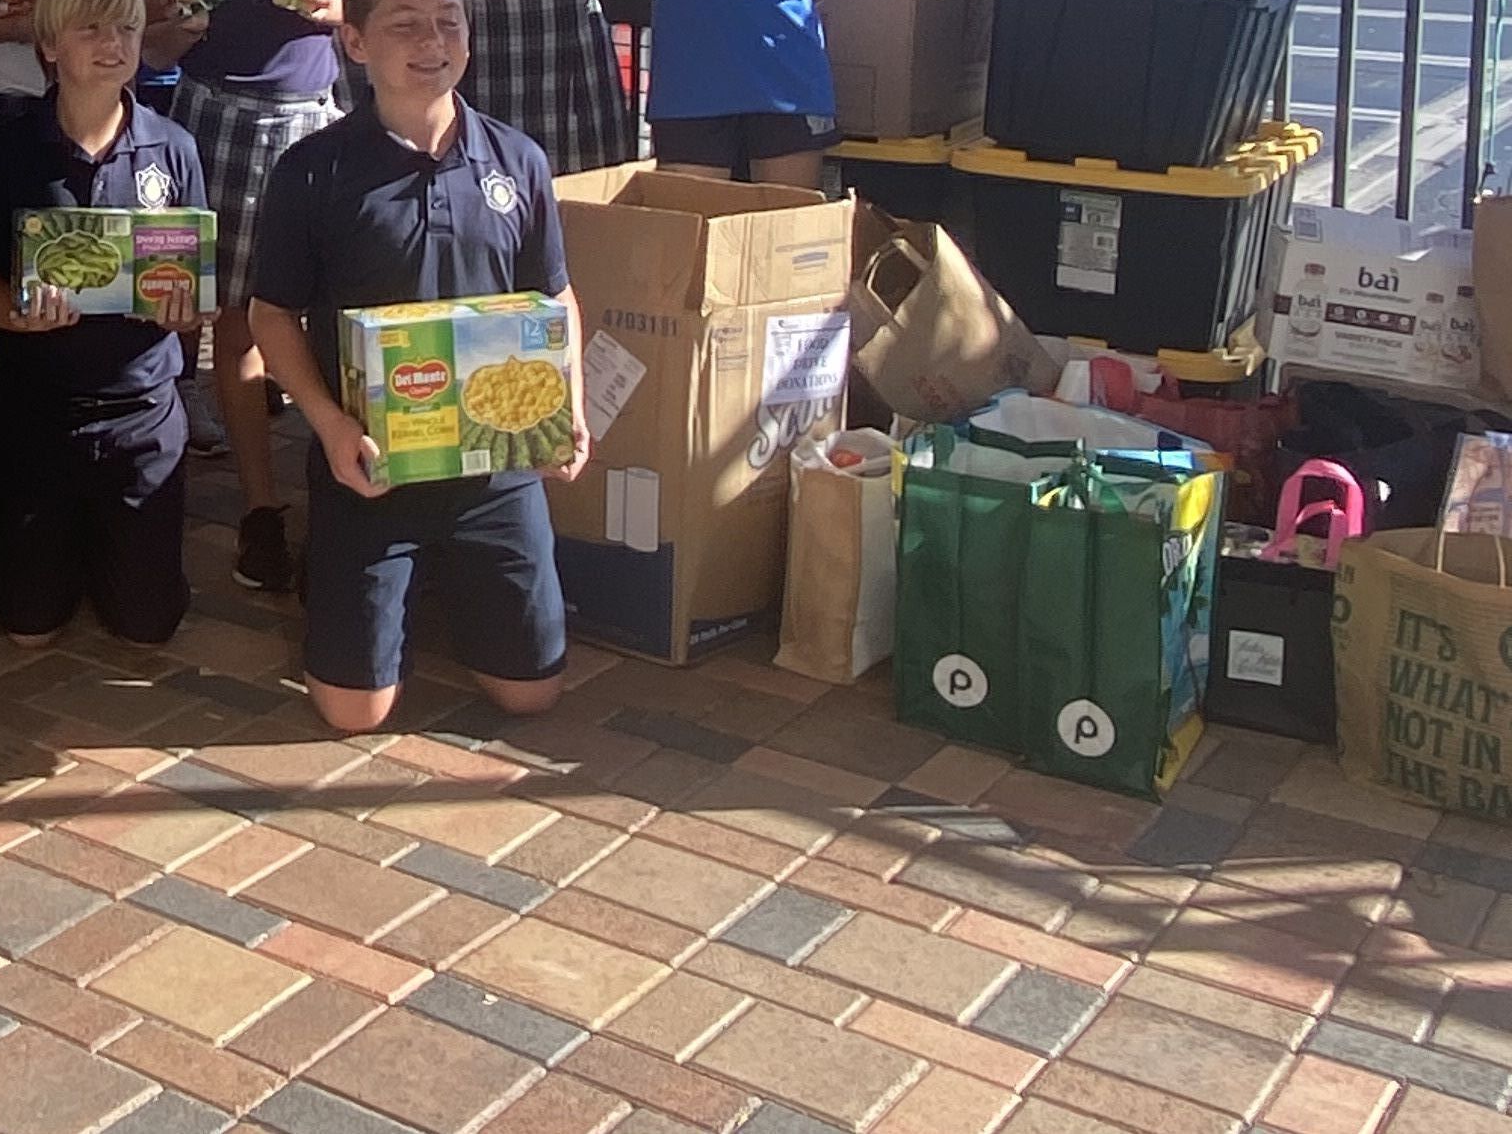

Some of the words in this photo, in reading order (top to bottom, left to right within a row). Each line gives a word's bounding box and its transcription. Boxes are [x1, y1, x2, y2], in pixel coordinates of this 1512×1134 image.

[1358, 266, 1399, 293] bai
[1390, 654, 1512, 724] WHAT'
[1389, 700, 1453, 758] NOT
[1461, 726, 1501, 774] IN
[1459, 774, 1512, 817] BA
